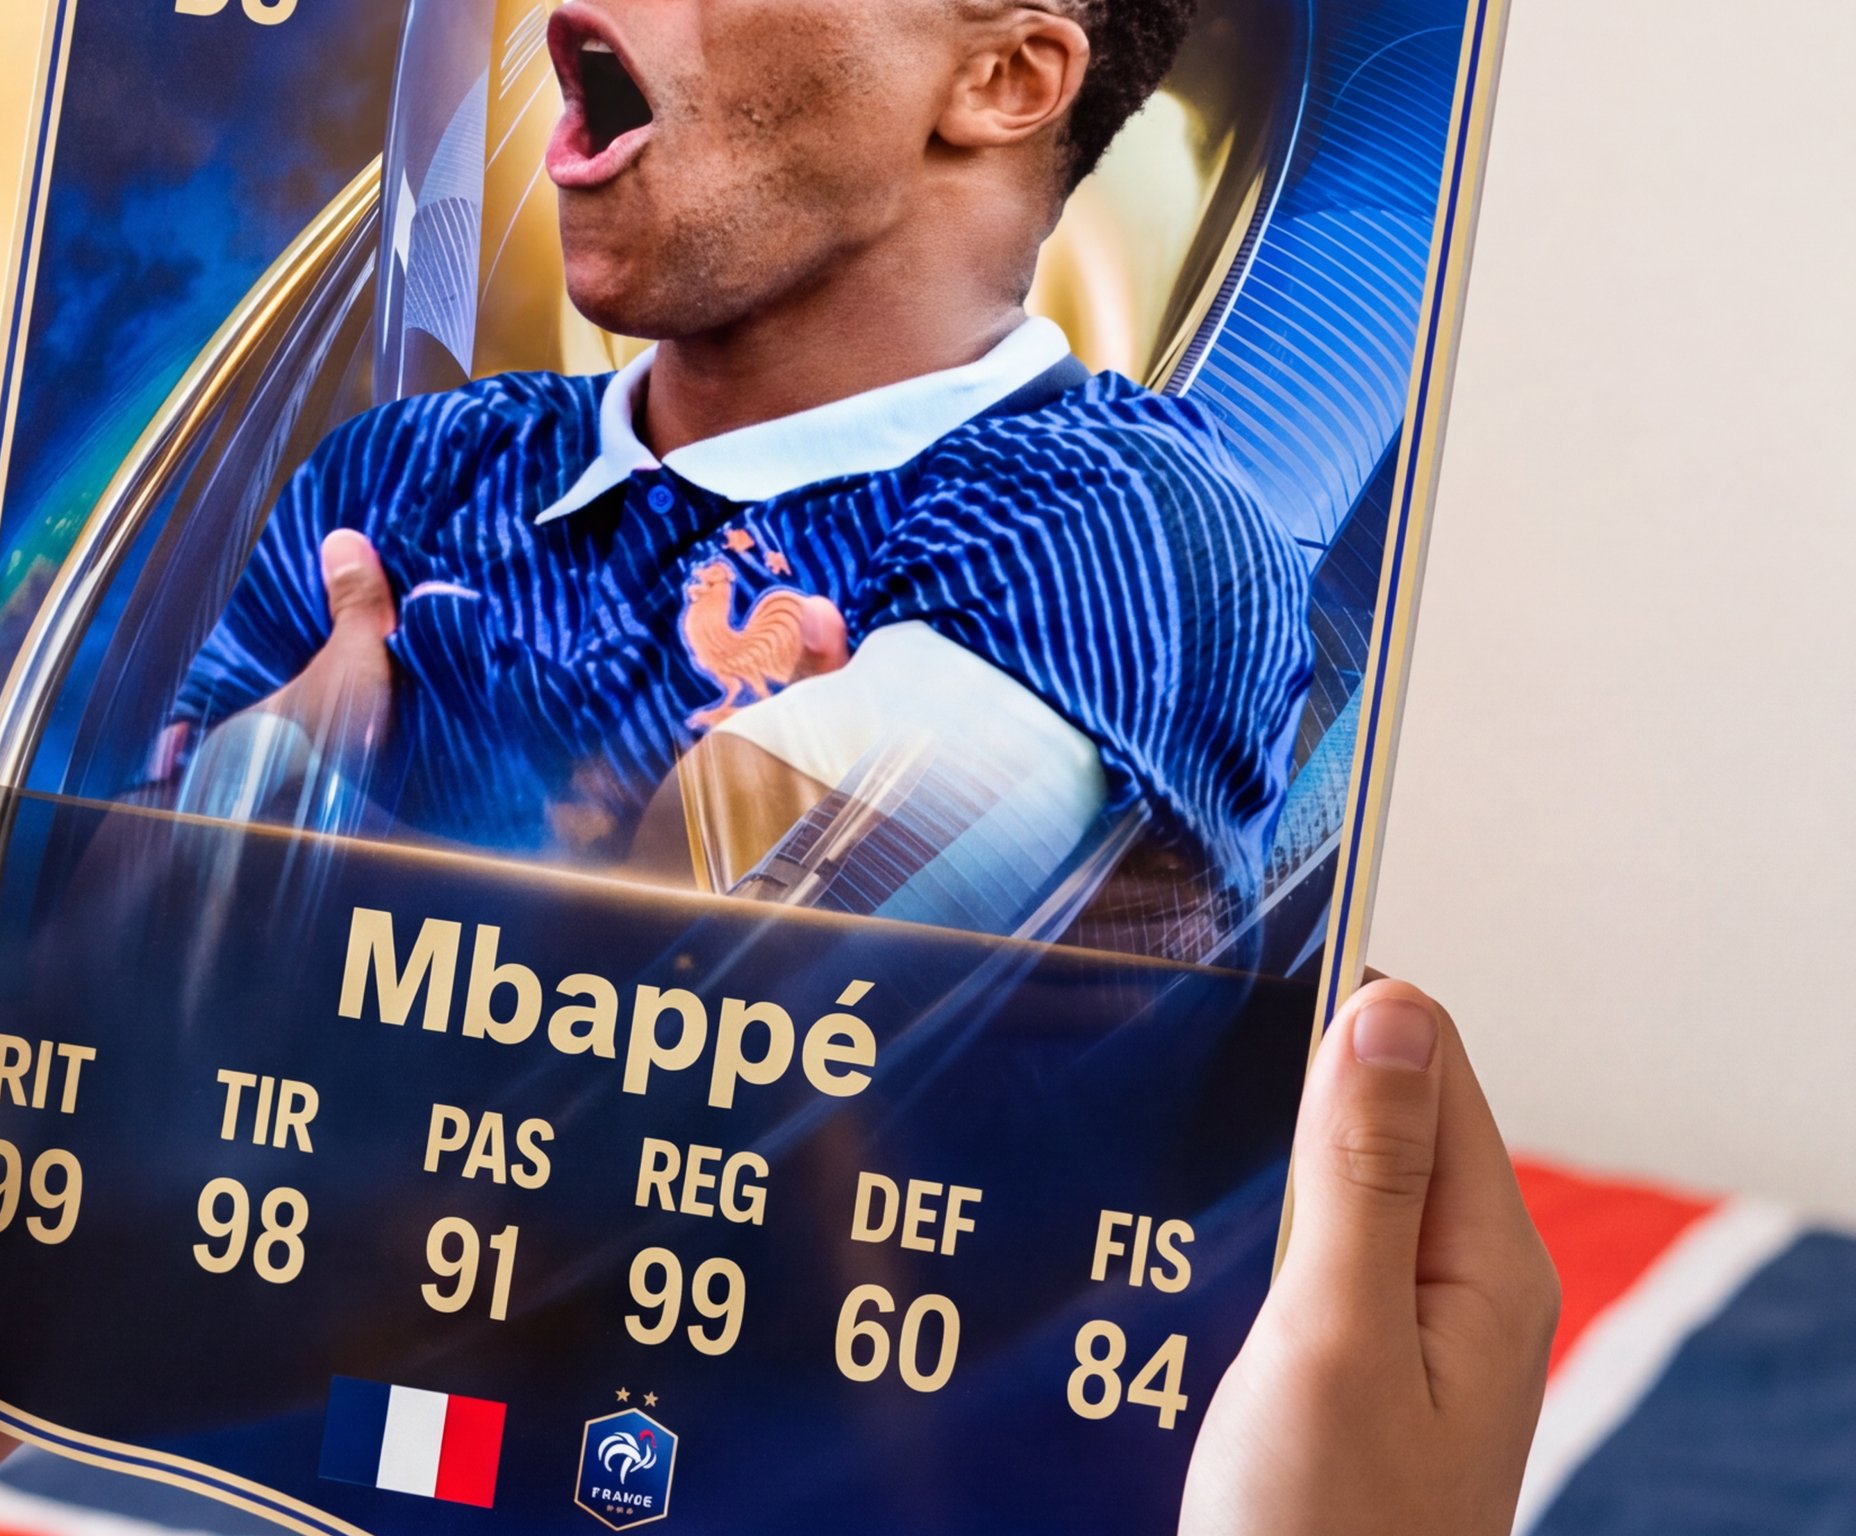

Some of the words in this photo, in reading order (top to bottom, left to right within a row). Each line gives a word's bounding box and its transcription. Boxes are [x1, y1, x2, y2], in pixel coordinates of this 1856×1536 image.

[338, 907, 878, 1109] Mbappé
[217, 1069, 319, 1153] TIR
[423, 1103, 555, 1189] PAS
[635, 1137, 769, 1226] REG
[850, 1171, 983, 1256] DEF
[1090, 1209, 1195, 1293] FIS
[193, 1177, 309, 1284] 98
[421, 1216, 519, 1321] 91
[624, 1247, 746, 1356] 99
[835, 1283, 960, 1393] 60
[1067, 1319, 1188, 1430] 84
